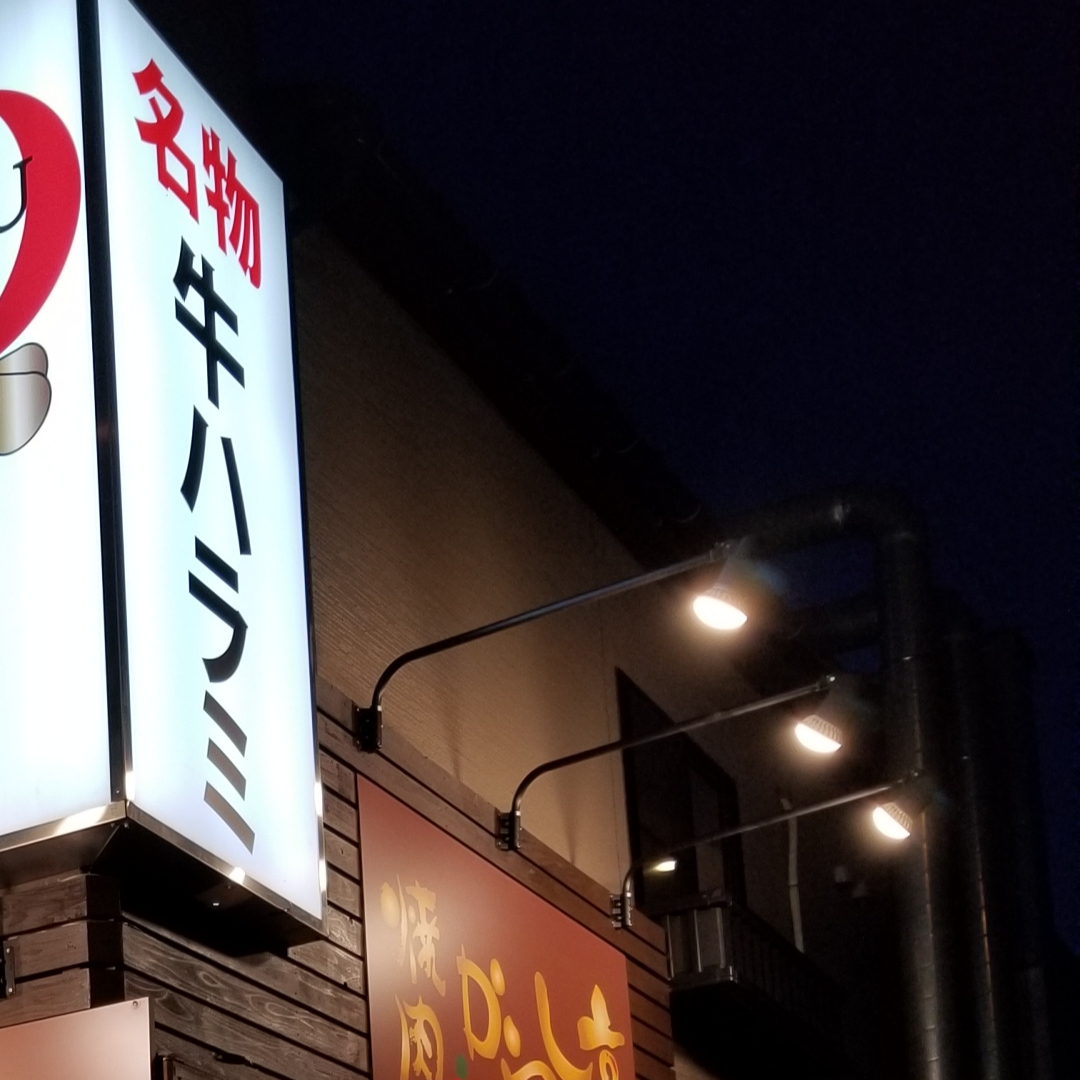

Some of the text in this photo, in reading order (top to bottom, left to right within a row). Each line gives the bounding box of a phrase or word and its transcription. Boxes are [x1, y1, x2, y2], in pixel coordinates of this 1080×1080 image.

[134, 58, 262, 290] 名物
[174, 236, 257, 855] 牛ハラミ
